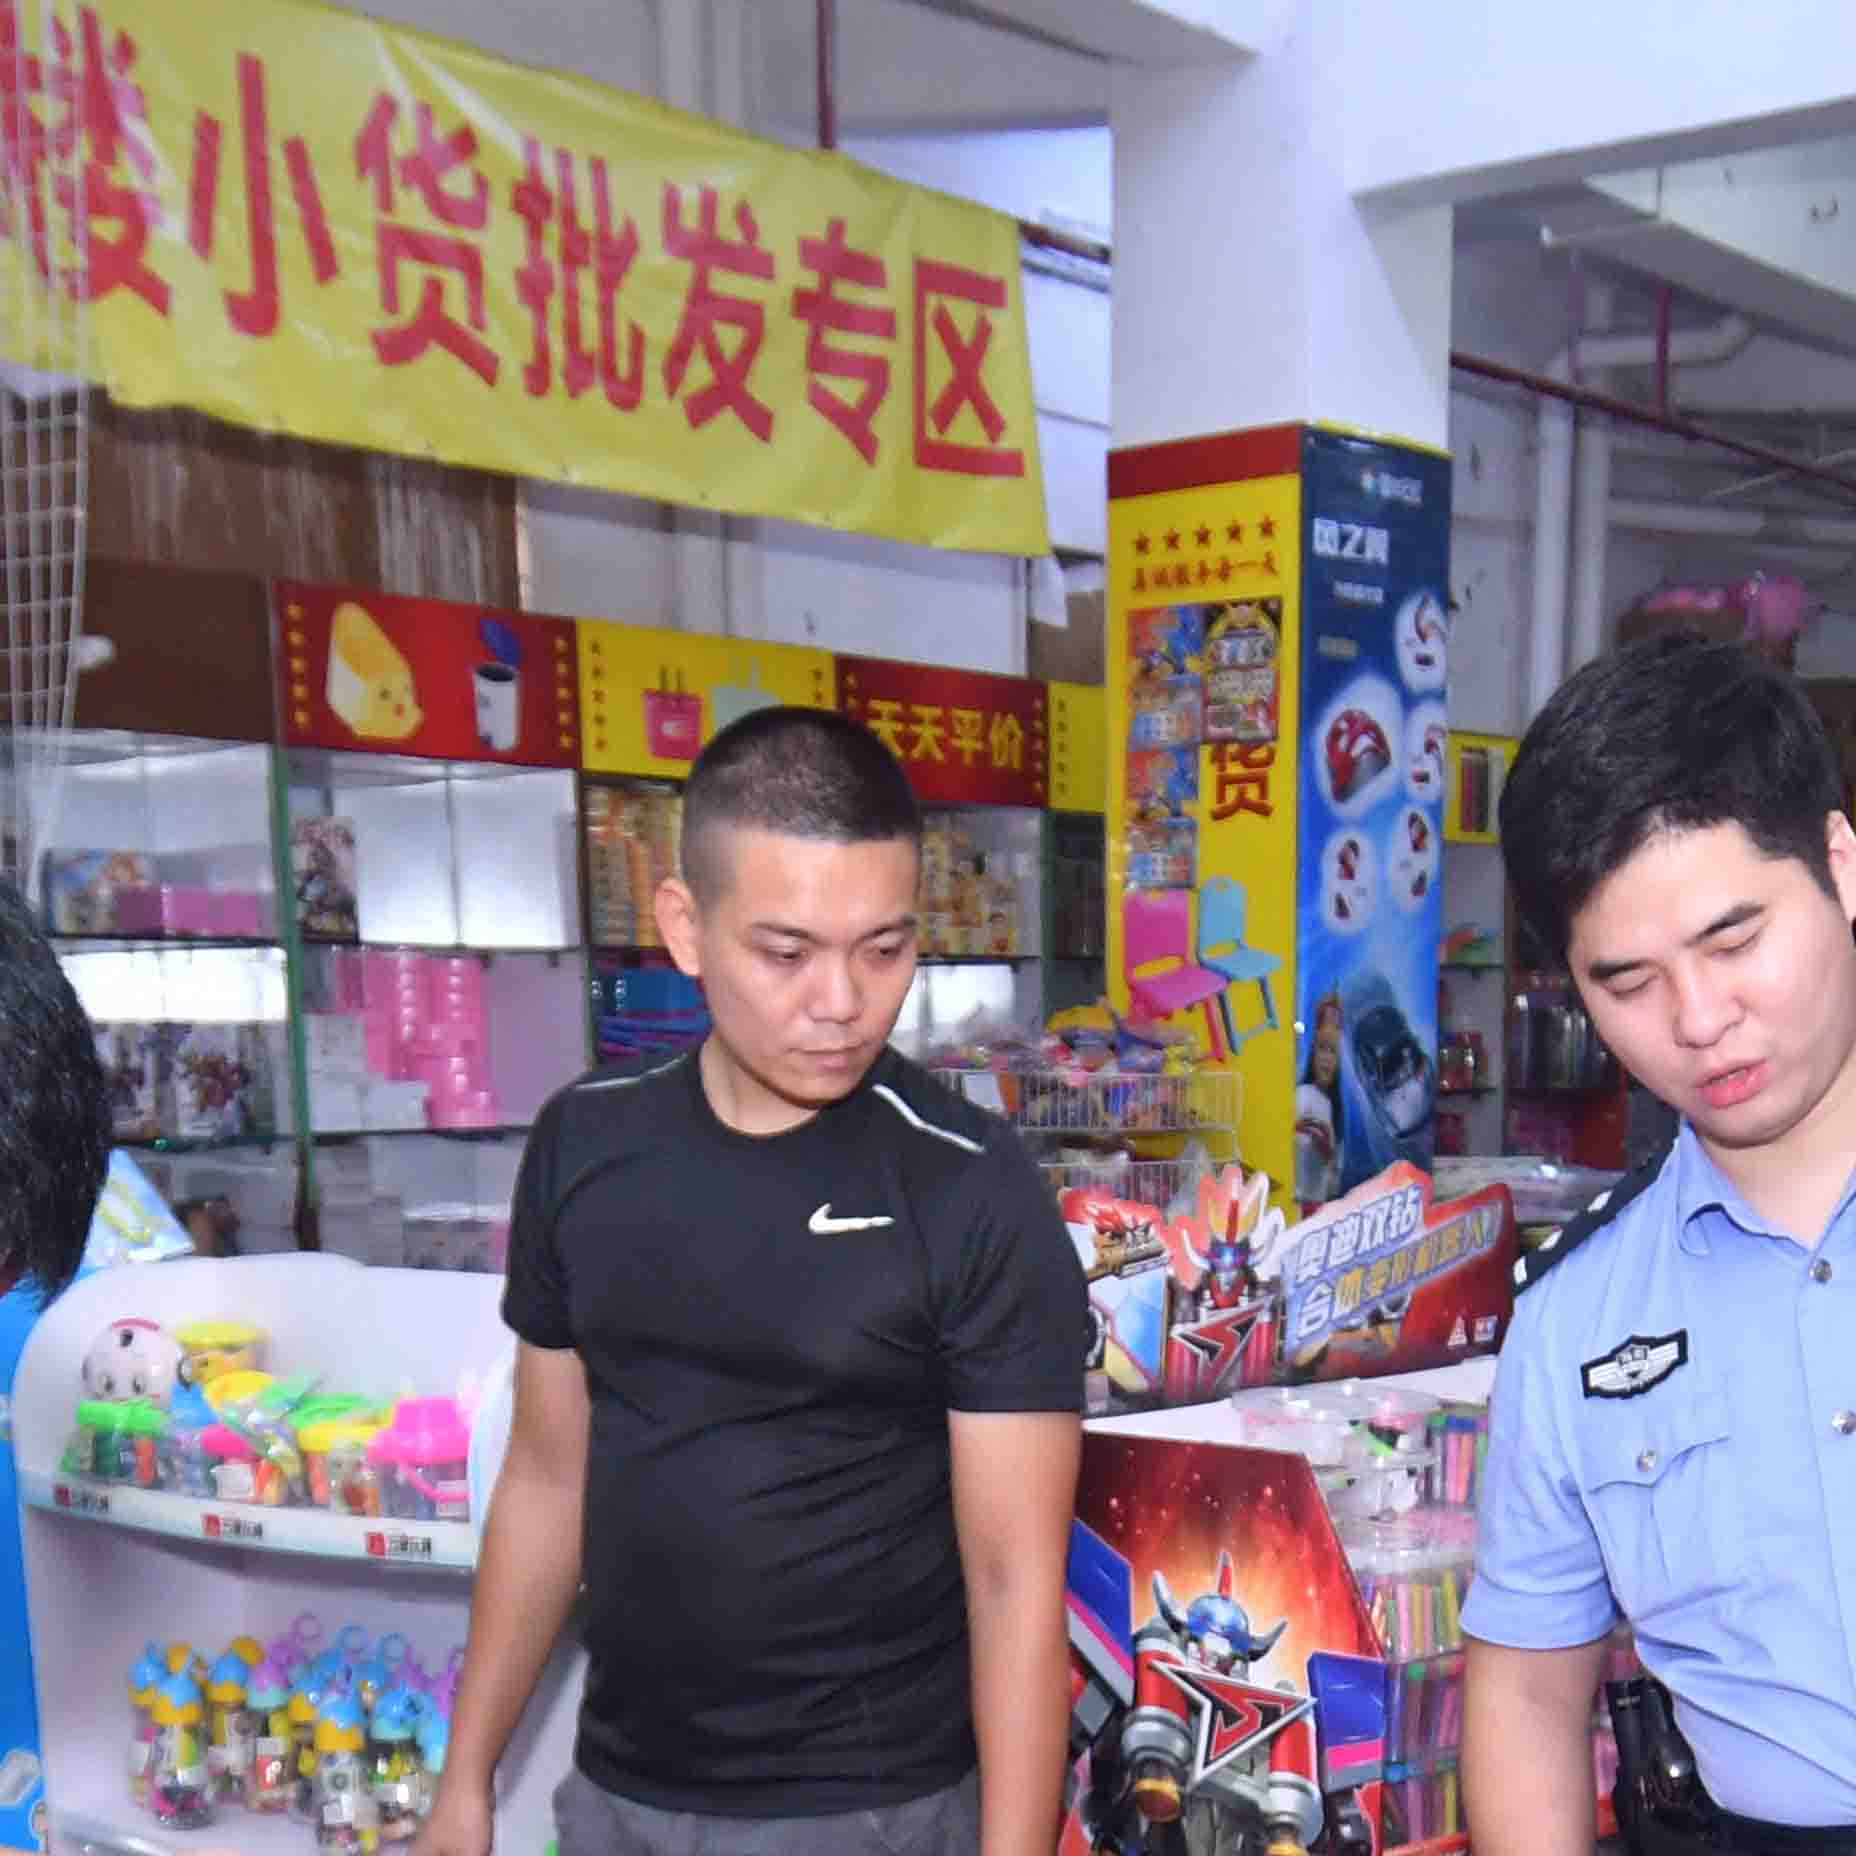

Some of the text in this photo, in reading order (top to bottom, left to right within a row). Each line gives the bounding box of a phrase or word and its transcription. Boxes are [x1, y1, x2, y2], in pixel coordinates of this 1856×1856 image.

[866, 697, 1027, 772] 天天平价
[1296, 1182, 1426, 1284] 奥迪双钻
